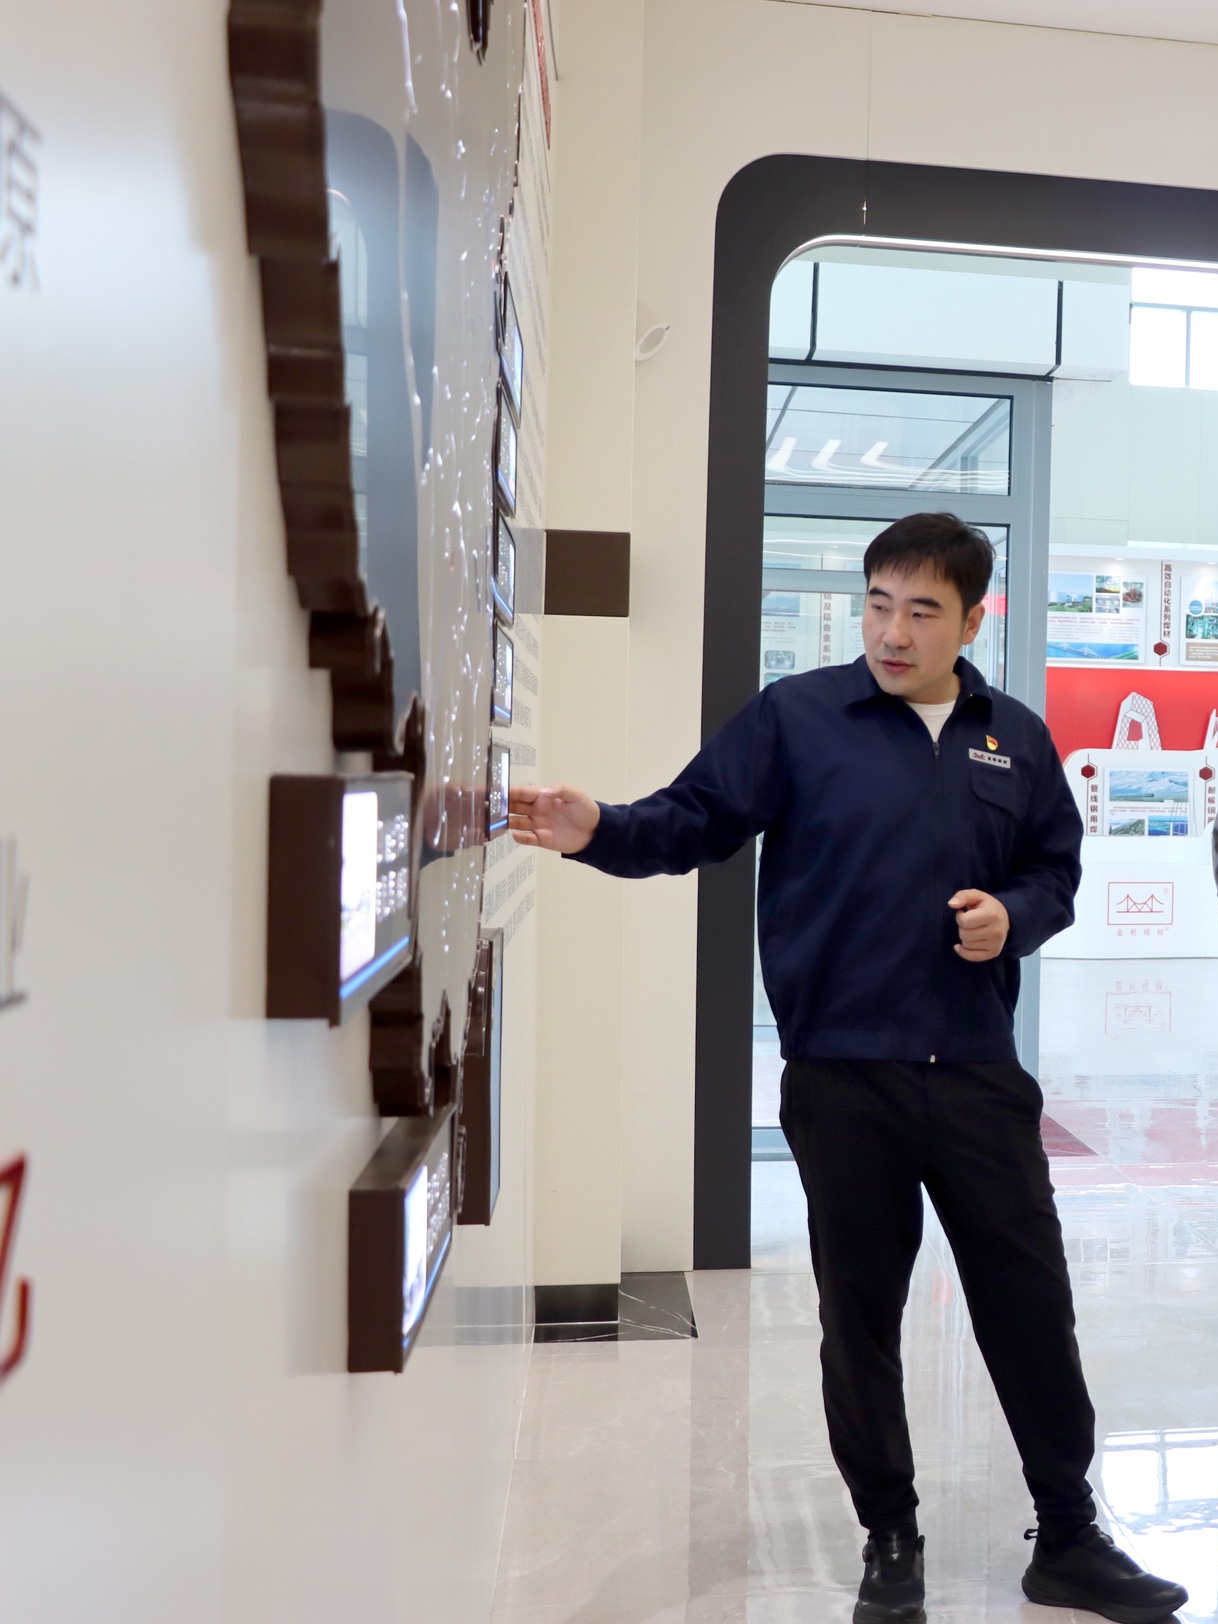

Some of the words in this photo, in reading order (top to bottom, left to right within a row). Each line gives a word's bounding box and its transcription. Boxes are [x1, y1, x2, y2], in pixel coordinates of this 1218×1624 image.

[1163, 563, 1173, 638] 高效自动化系列焊材
[1089, 784, 1099, 833] 管线钢用焊
